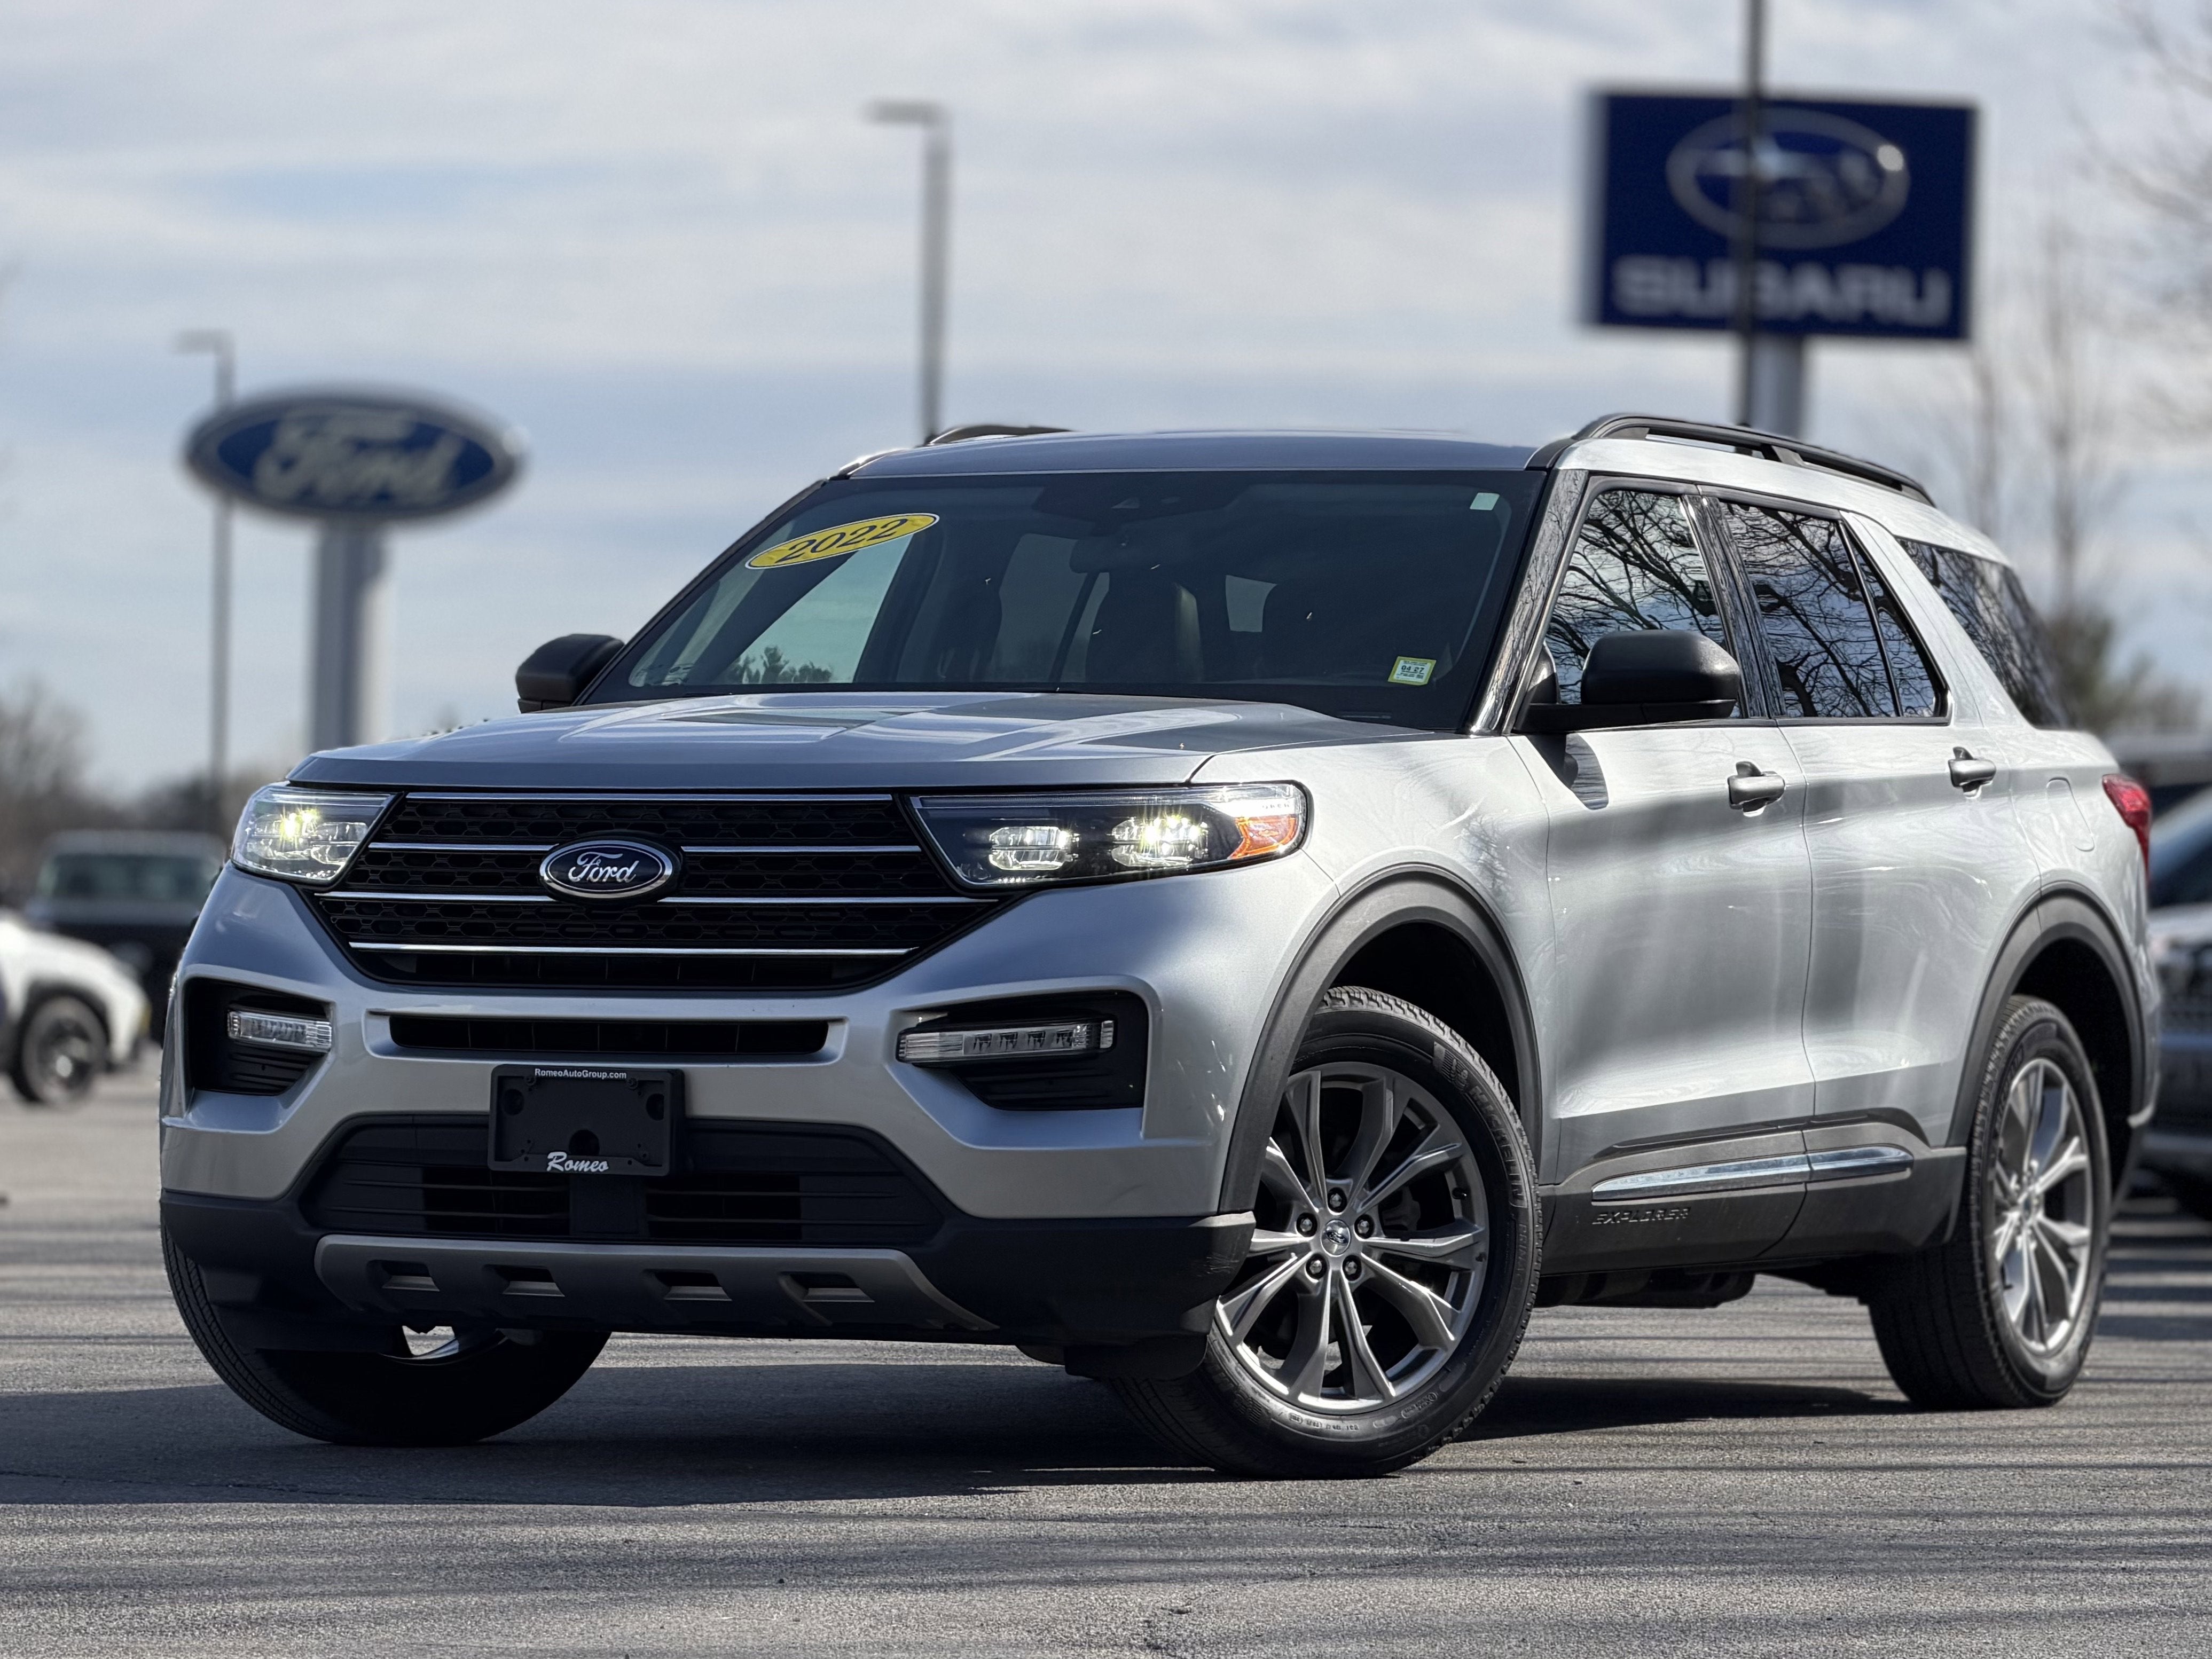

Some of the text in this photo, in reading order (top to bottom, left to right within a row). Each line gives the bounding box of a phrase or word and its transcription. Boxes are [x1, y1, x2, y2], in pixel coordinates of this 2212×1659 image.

[1611, 254, 1952, 327] SUBARU
[254, 405, 465, 505] Ford
[774, 518, 908, 563] 2022
[568, 852, 639, 883] Ford
[535, 1068, 627, 1079] RomeoAutoGroup.com
[1469, 1085, 1524, 1198] MICHELIN
[547, 1152, 609, 1172] Romeo
[1592, 1207, 1691, 1225] EXPLORER
